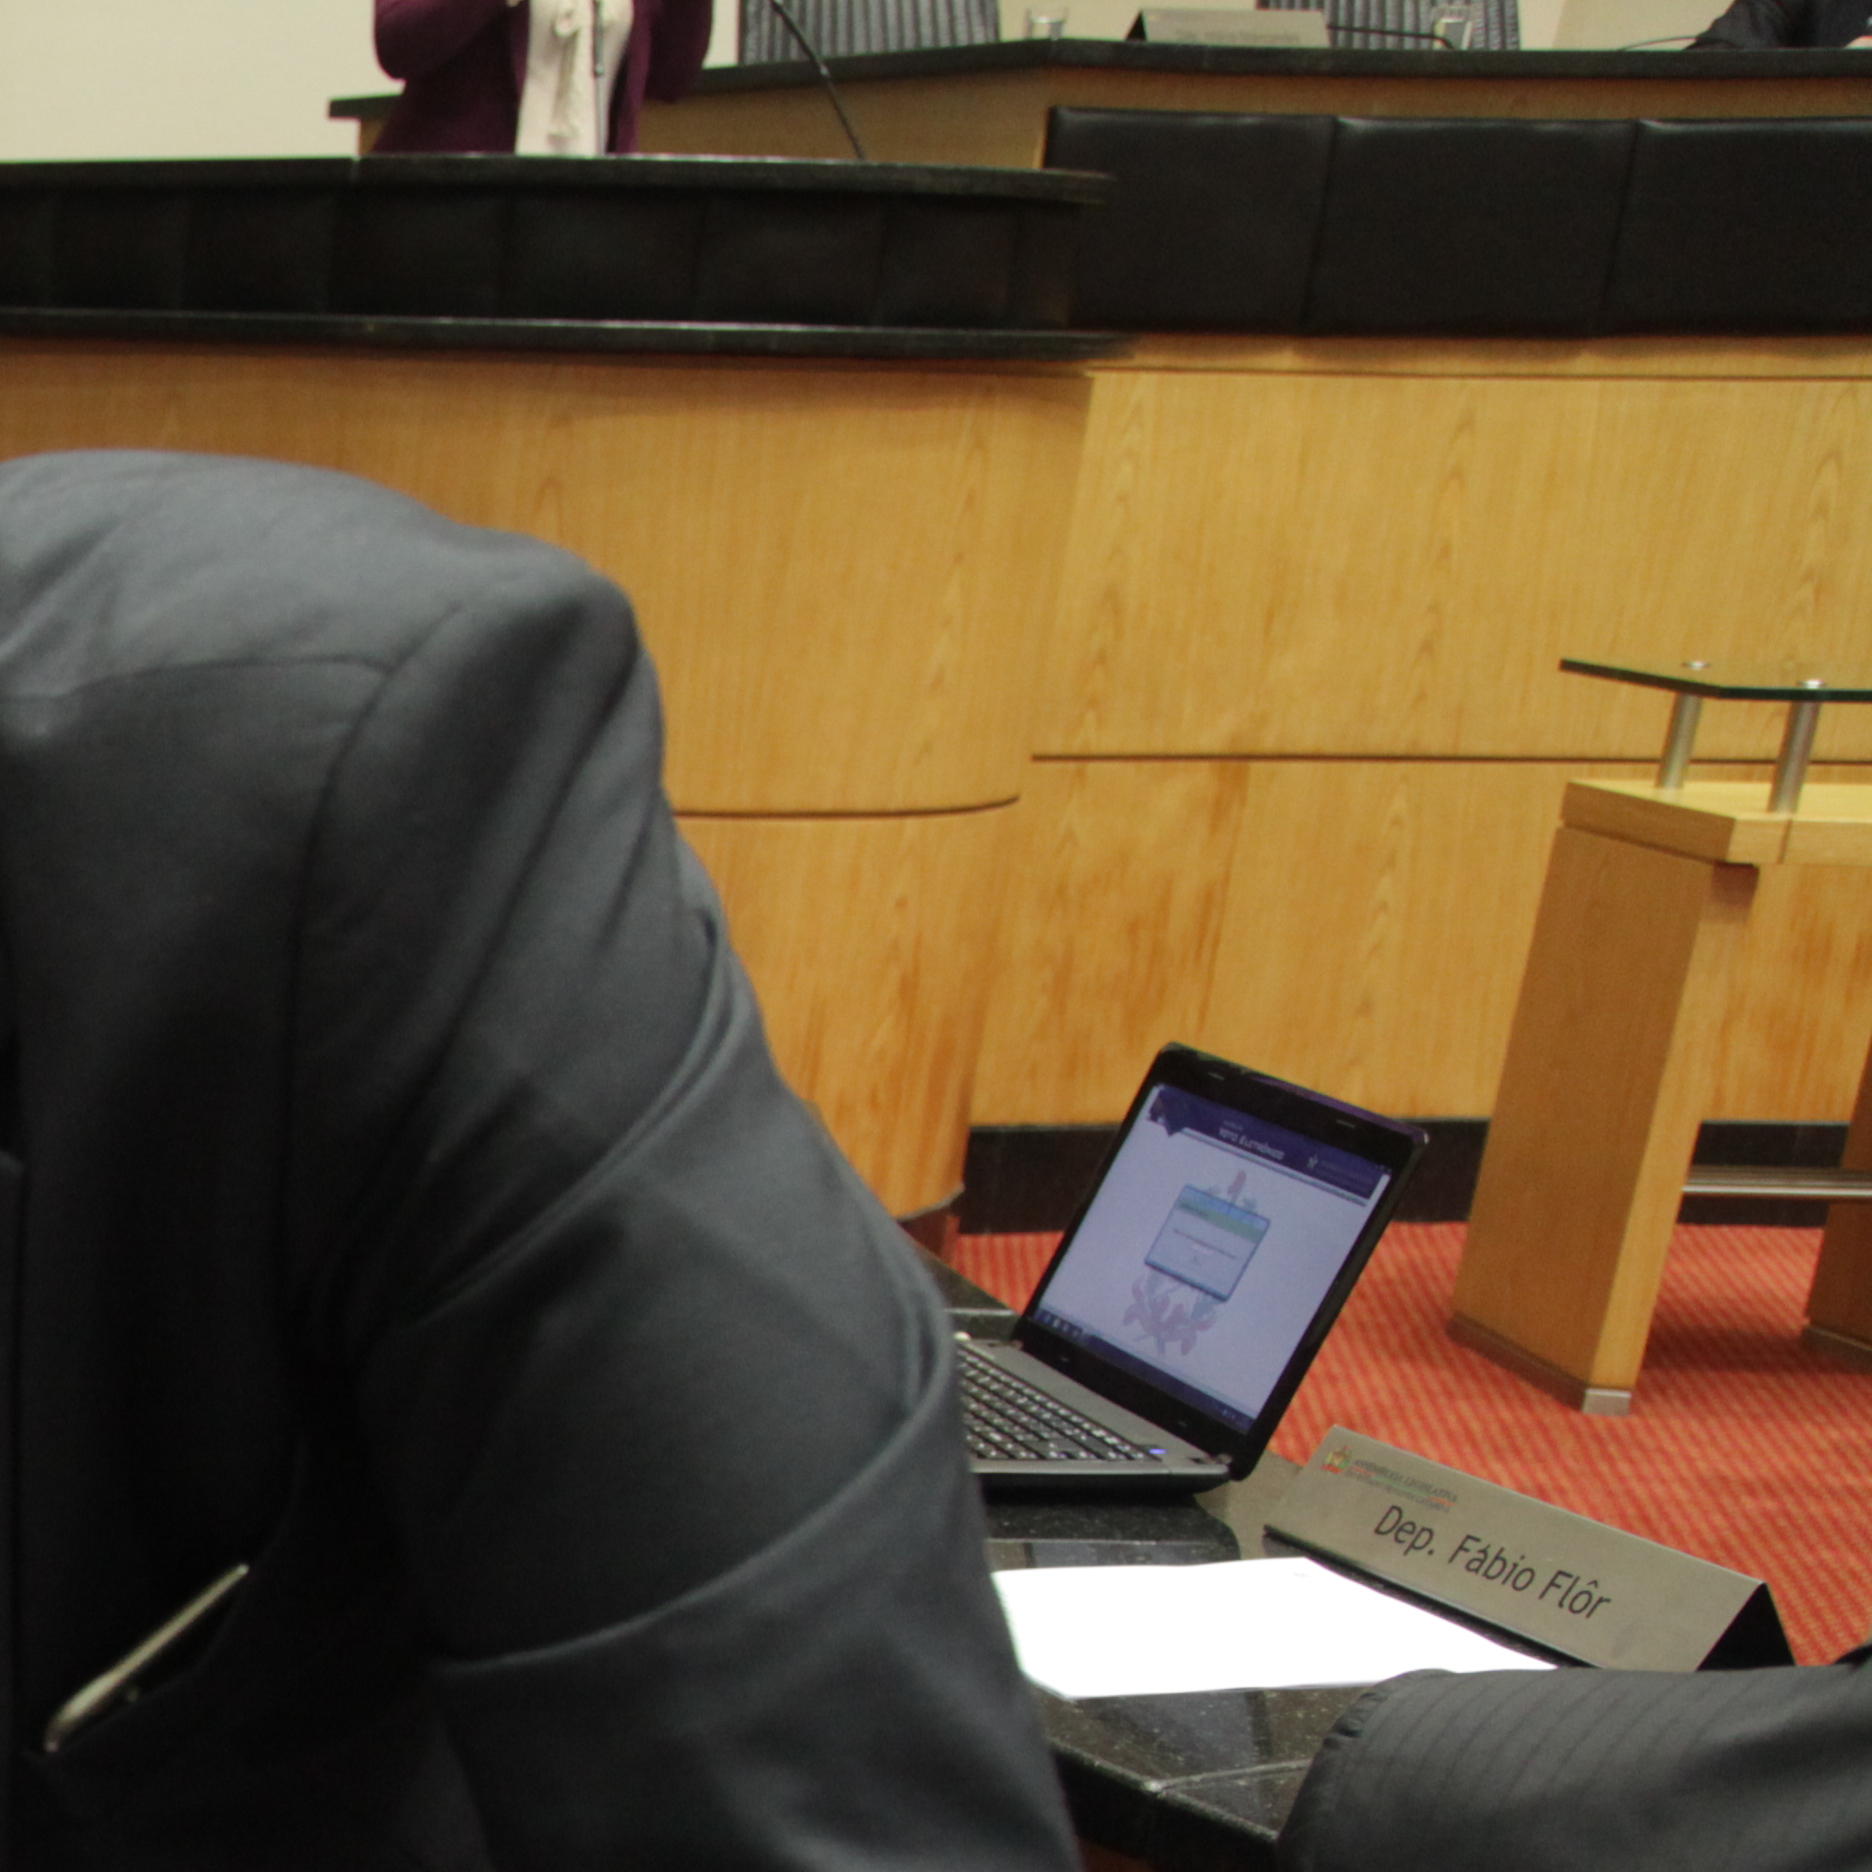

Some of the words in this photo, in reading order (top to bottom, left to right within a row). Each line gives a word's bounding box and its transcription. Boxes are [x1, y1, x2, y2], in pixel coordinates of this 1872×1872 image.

[1374, 1504, 1434, 1556] Dep.
[1448, 1534, 1536, 1592] Fábio
[1538, 1570, 1612, 1620] Flôr
